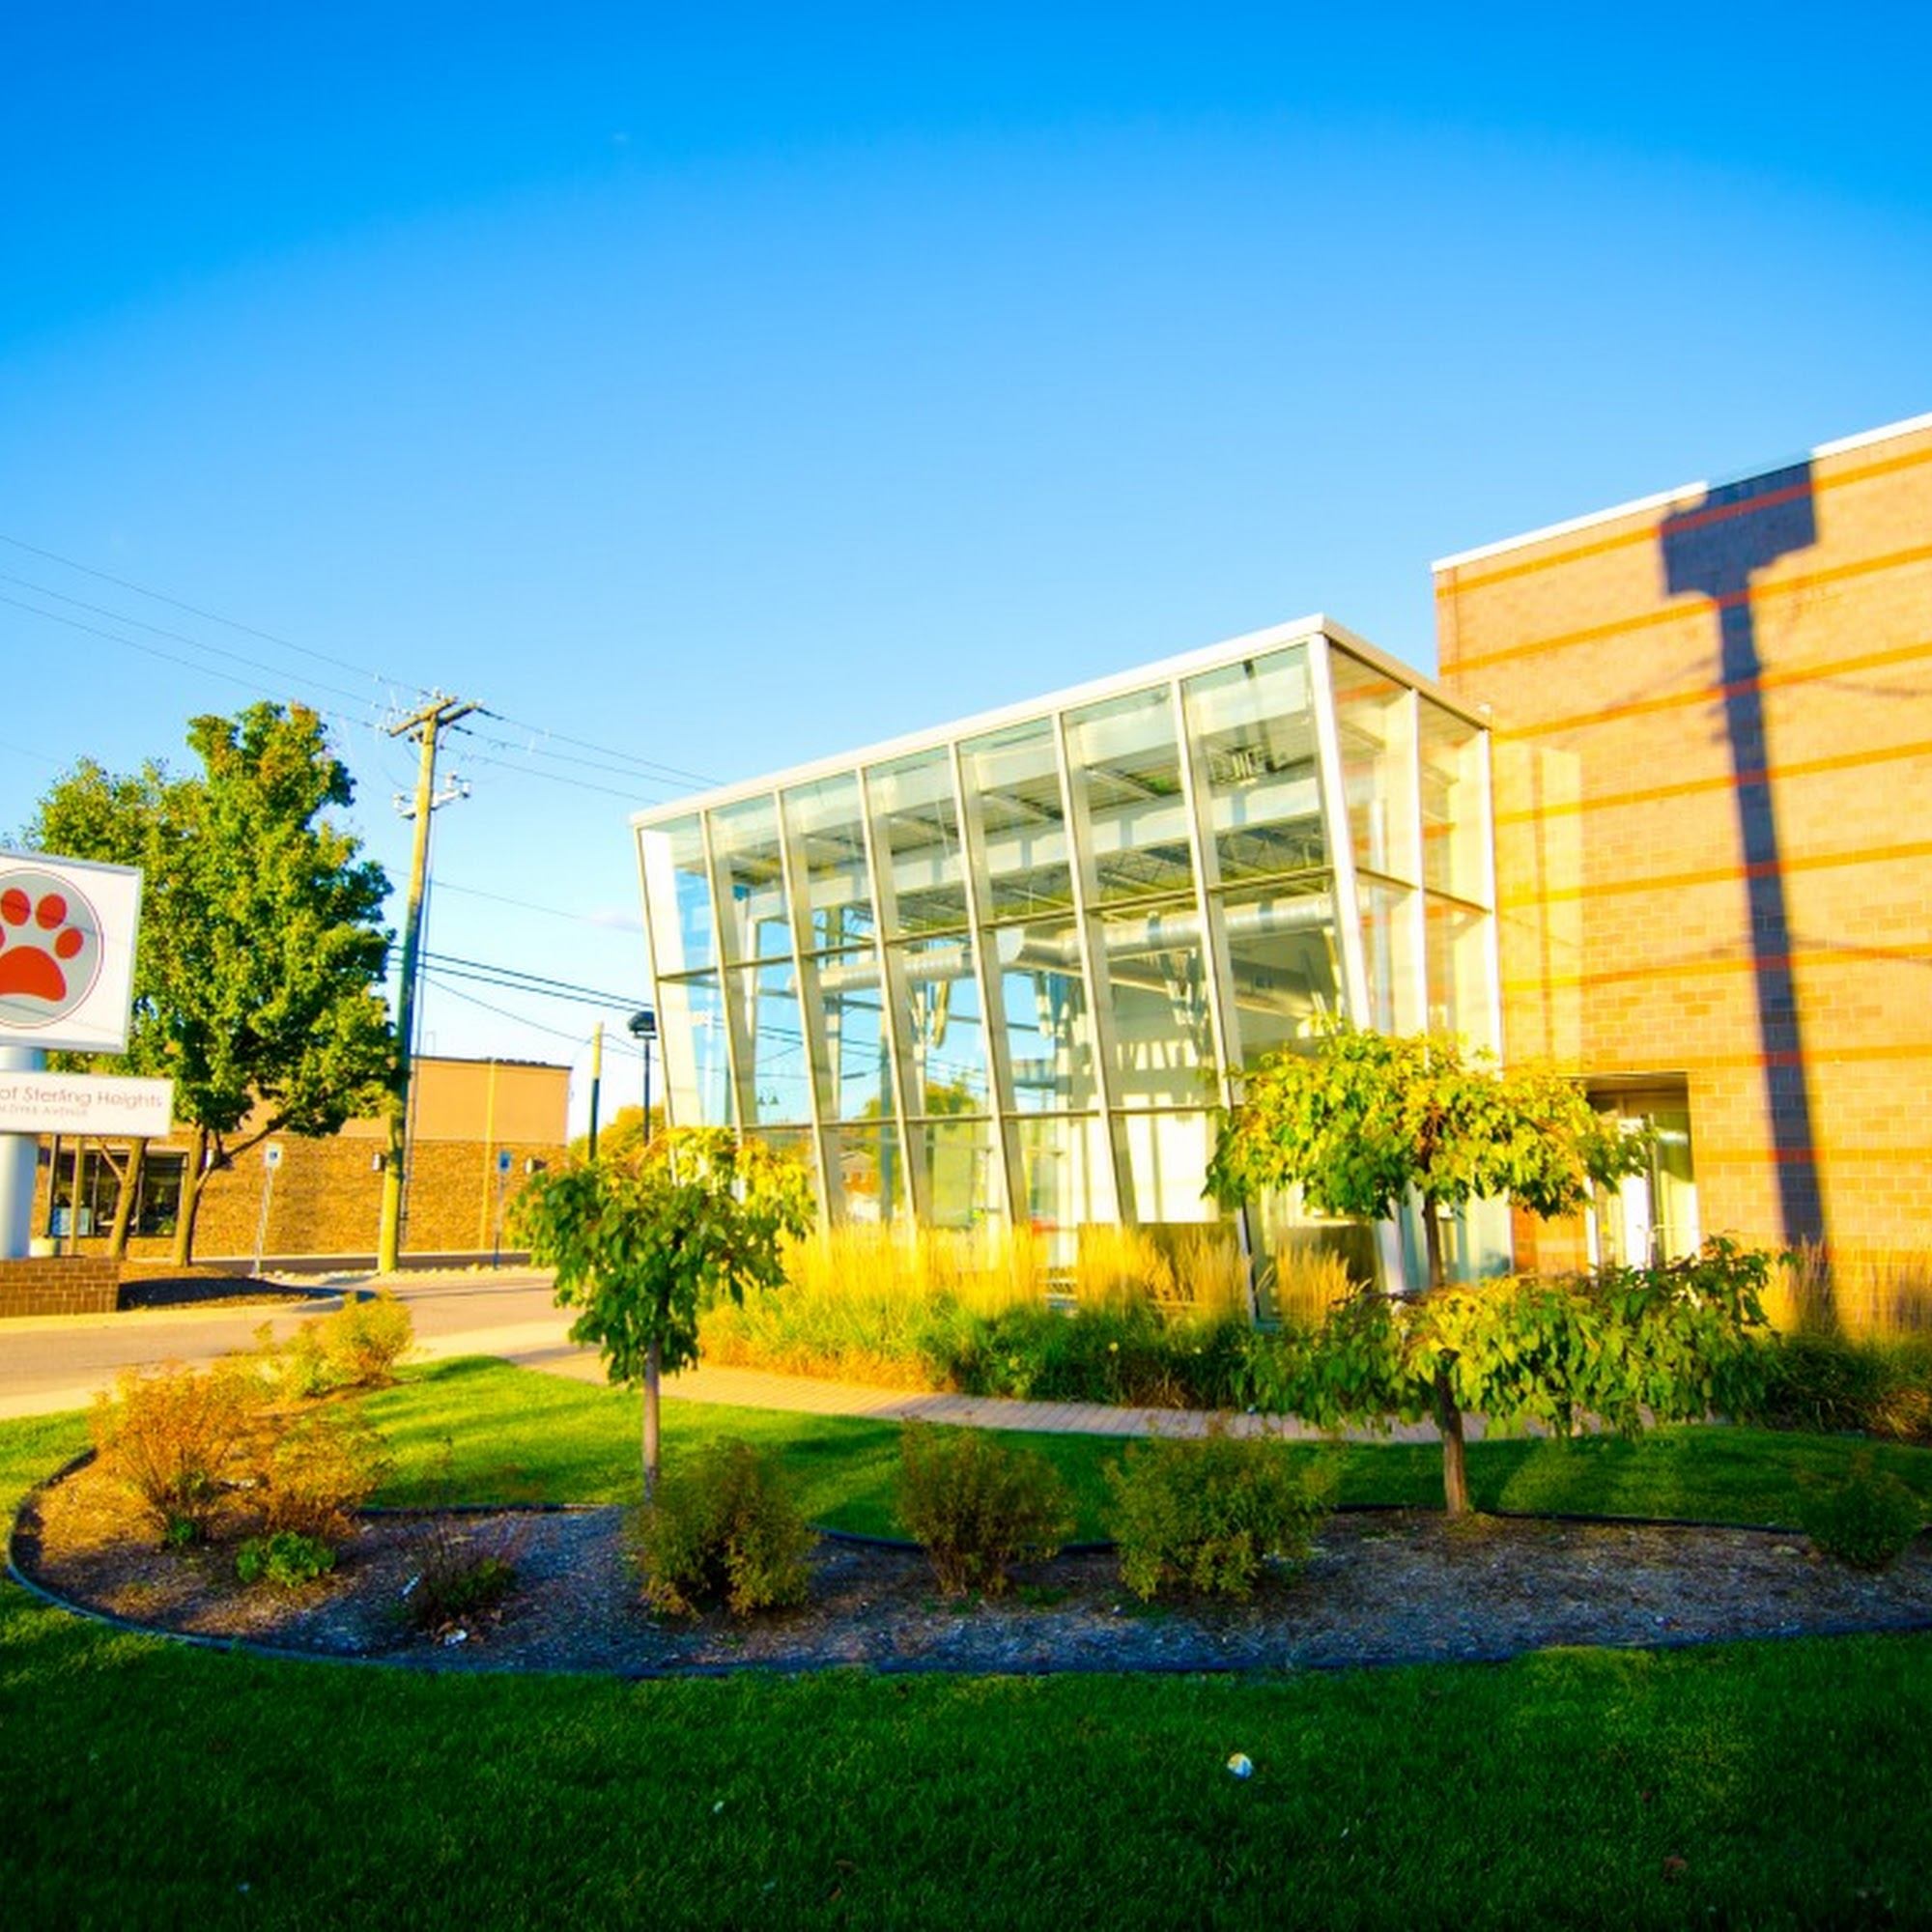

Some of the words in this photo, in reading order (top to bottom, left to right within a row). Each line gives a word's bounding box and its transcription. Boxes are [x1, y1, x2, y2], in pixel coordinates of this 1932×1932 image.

[0, 1086, 17, 1100] of
[23, 1086, 92, 1107] Sterling
[98, 1091, 162, 1110] Heights
